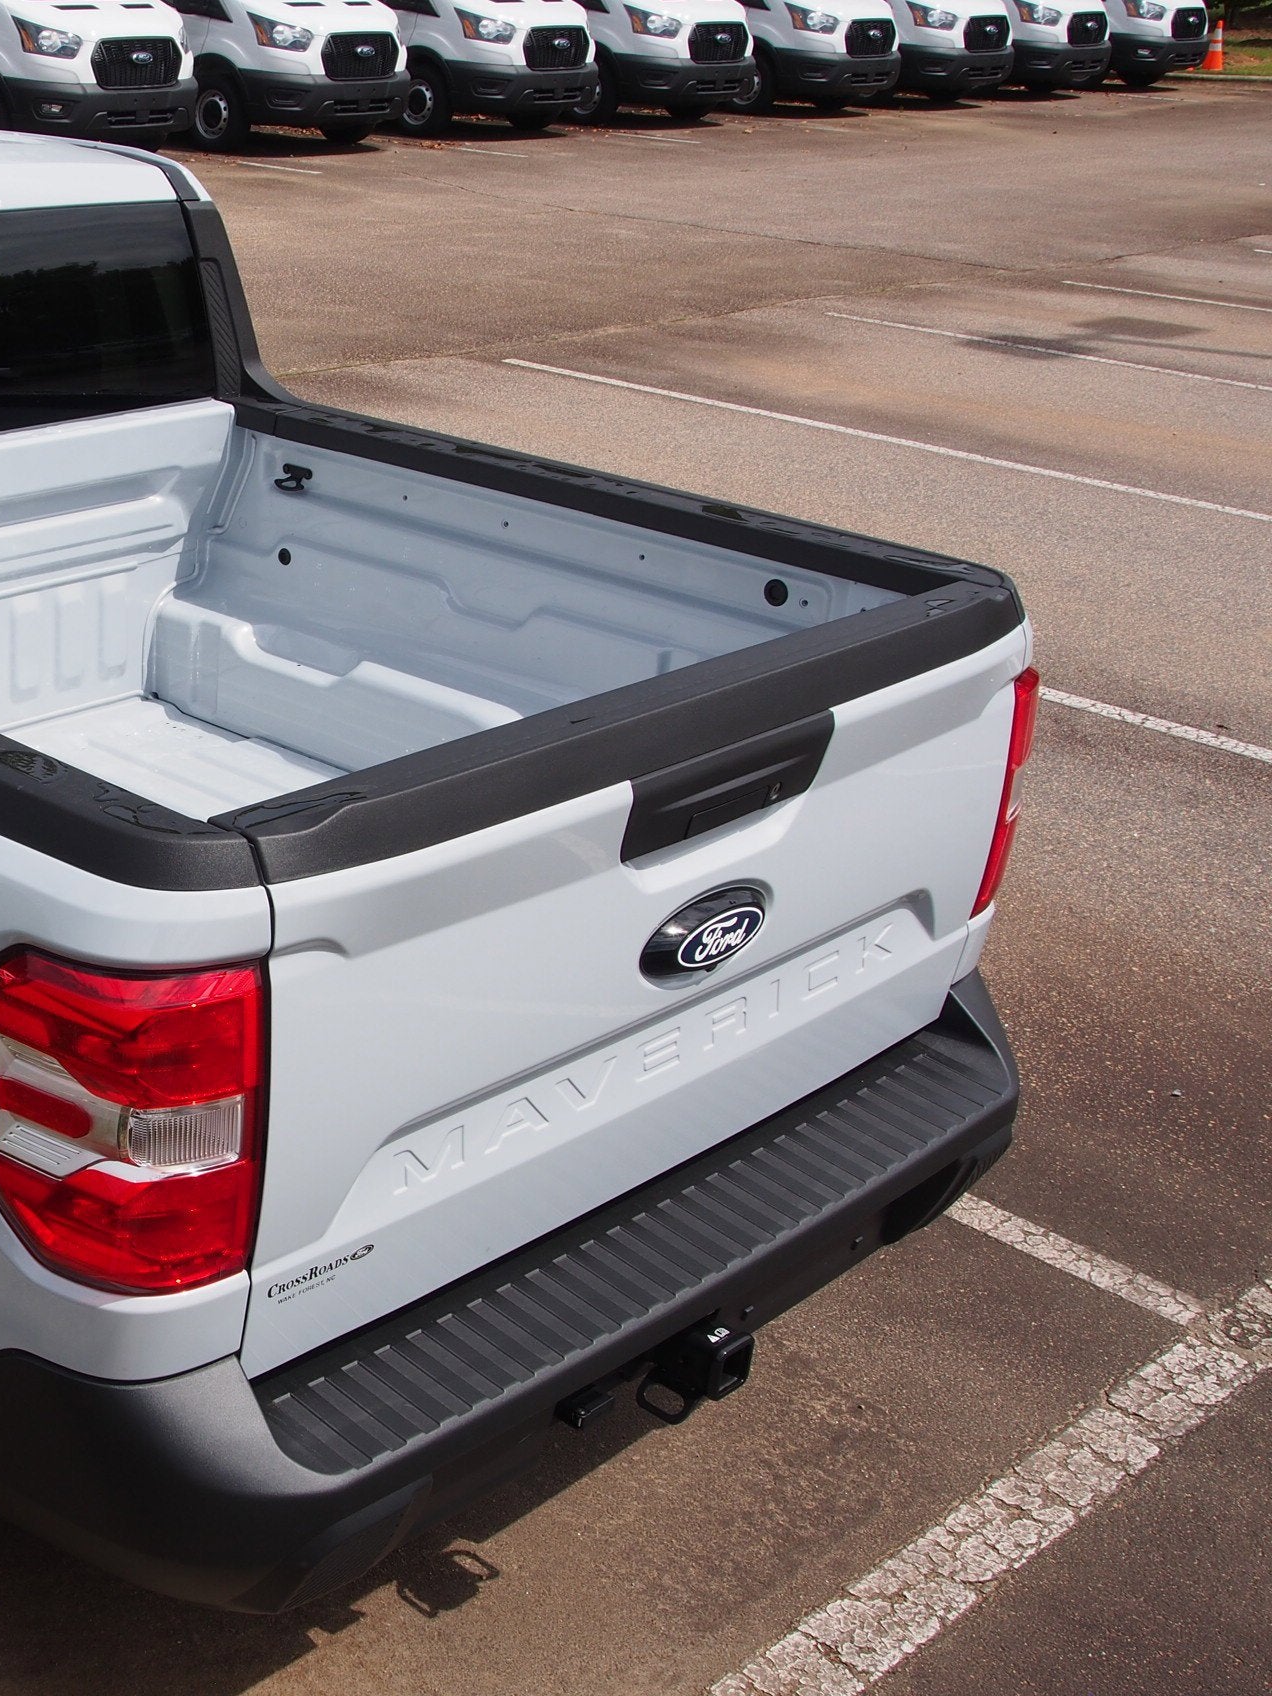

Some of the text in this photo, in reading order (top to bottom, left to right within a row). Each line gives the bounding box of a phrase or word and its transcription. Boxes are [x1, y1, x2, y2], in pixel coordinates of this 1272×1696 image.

[695, 916, 749, 961] Ford
[392, 923, 893, 1195] MAVERICK
[277, 1293, 295, 1304] WAKE
